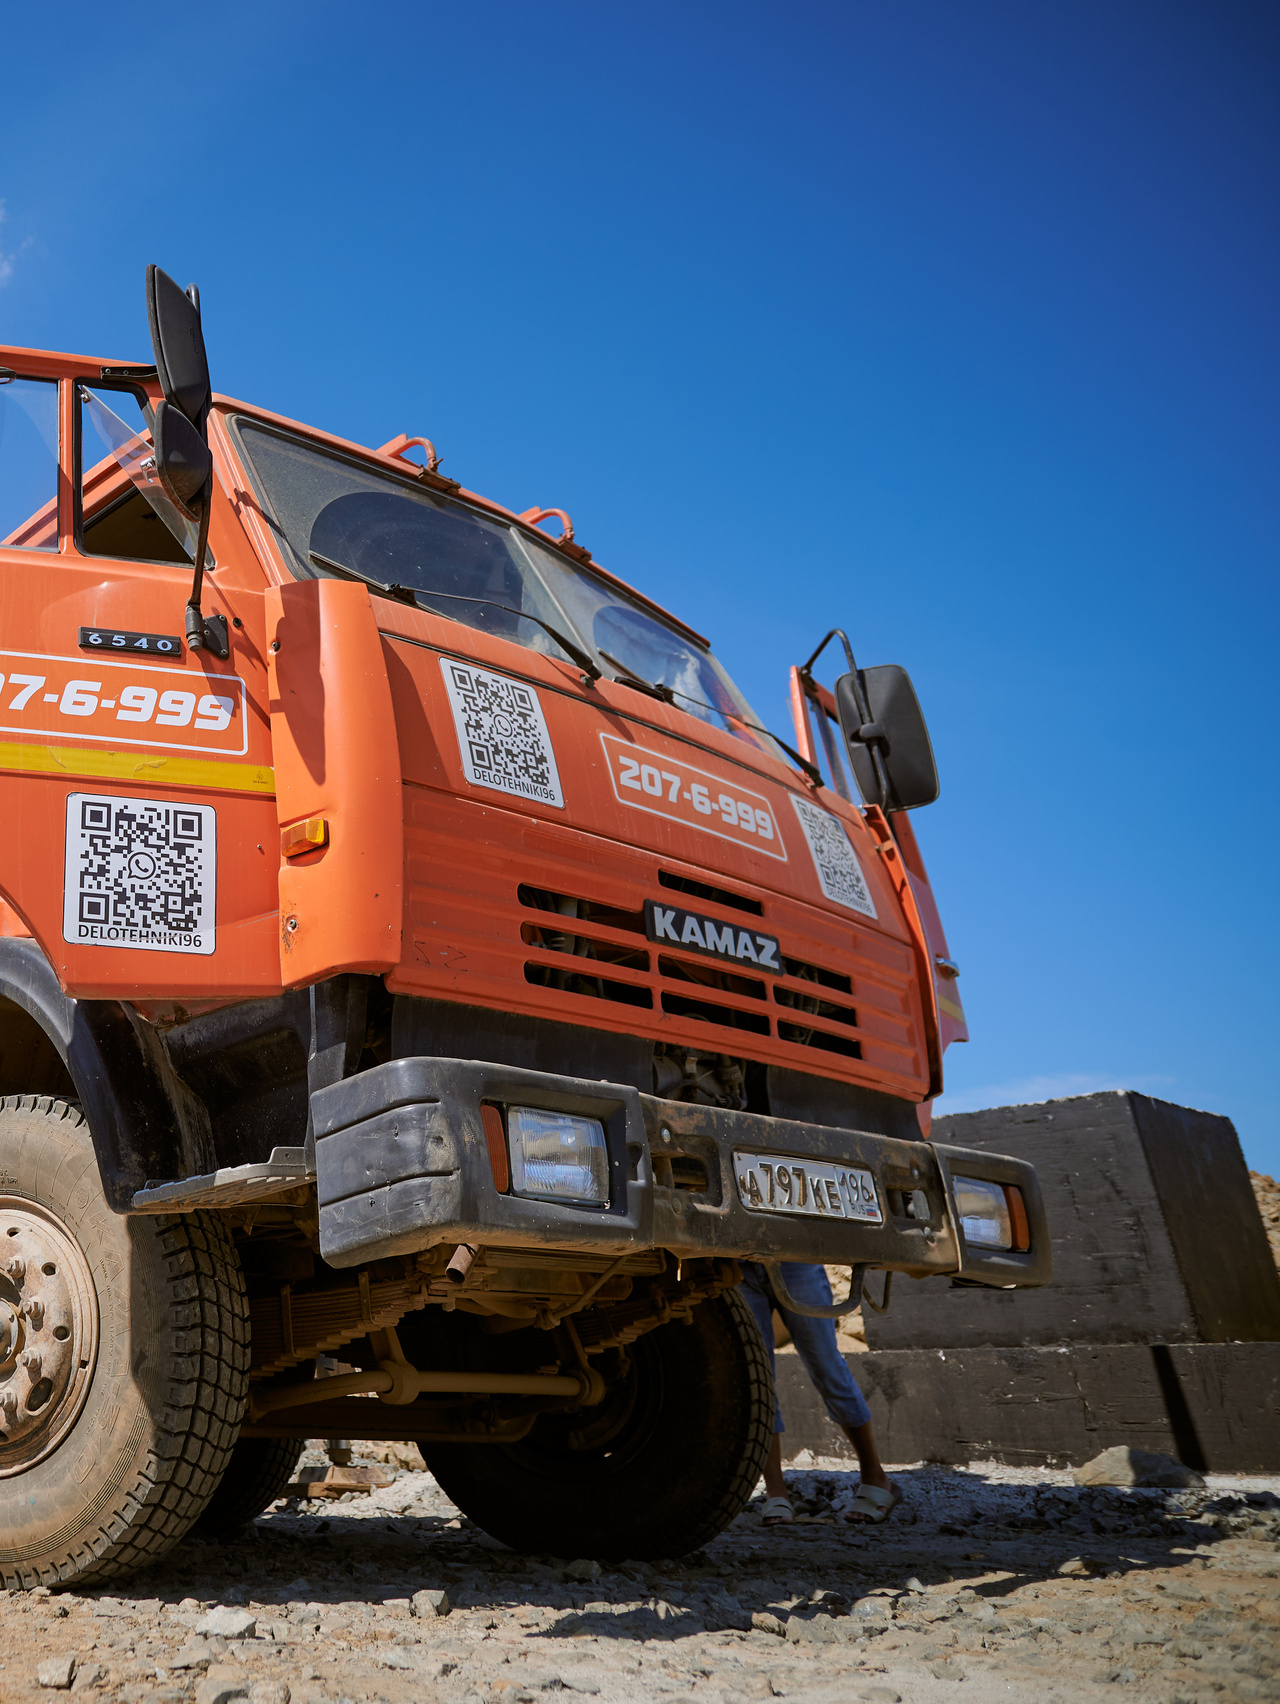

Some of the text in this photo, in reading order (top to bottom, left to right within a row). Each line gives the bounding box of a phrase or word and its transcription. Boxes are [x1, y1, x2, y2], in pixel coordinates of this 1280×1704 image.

[88, 632, 173, 652] 6540
[473, 768, 557, 802] DELOTEHNIKI96
[618, 755, 775, 841] 207-6-999
[77, 923, 203, 949] DELOTEHNIKI96
[653, 906, 780, 970] KAMAZ
[839, 1172, 871, 1203] 196
[850, 1202, 867, 1215] RUS
